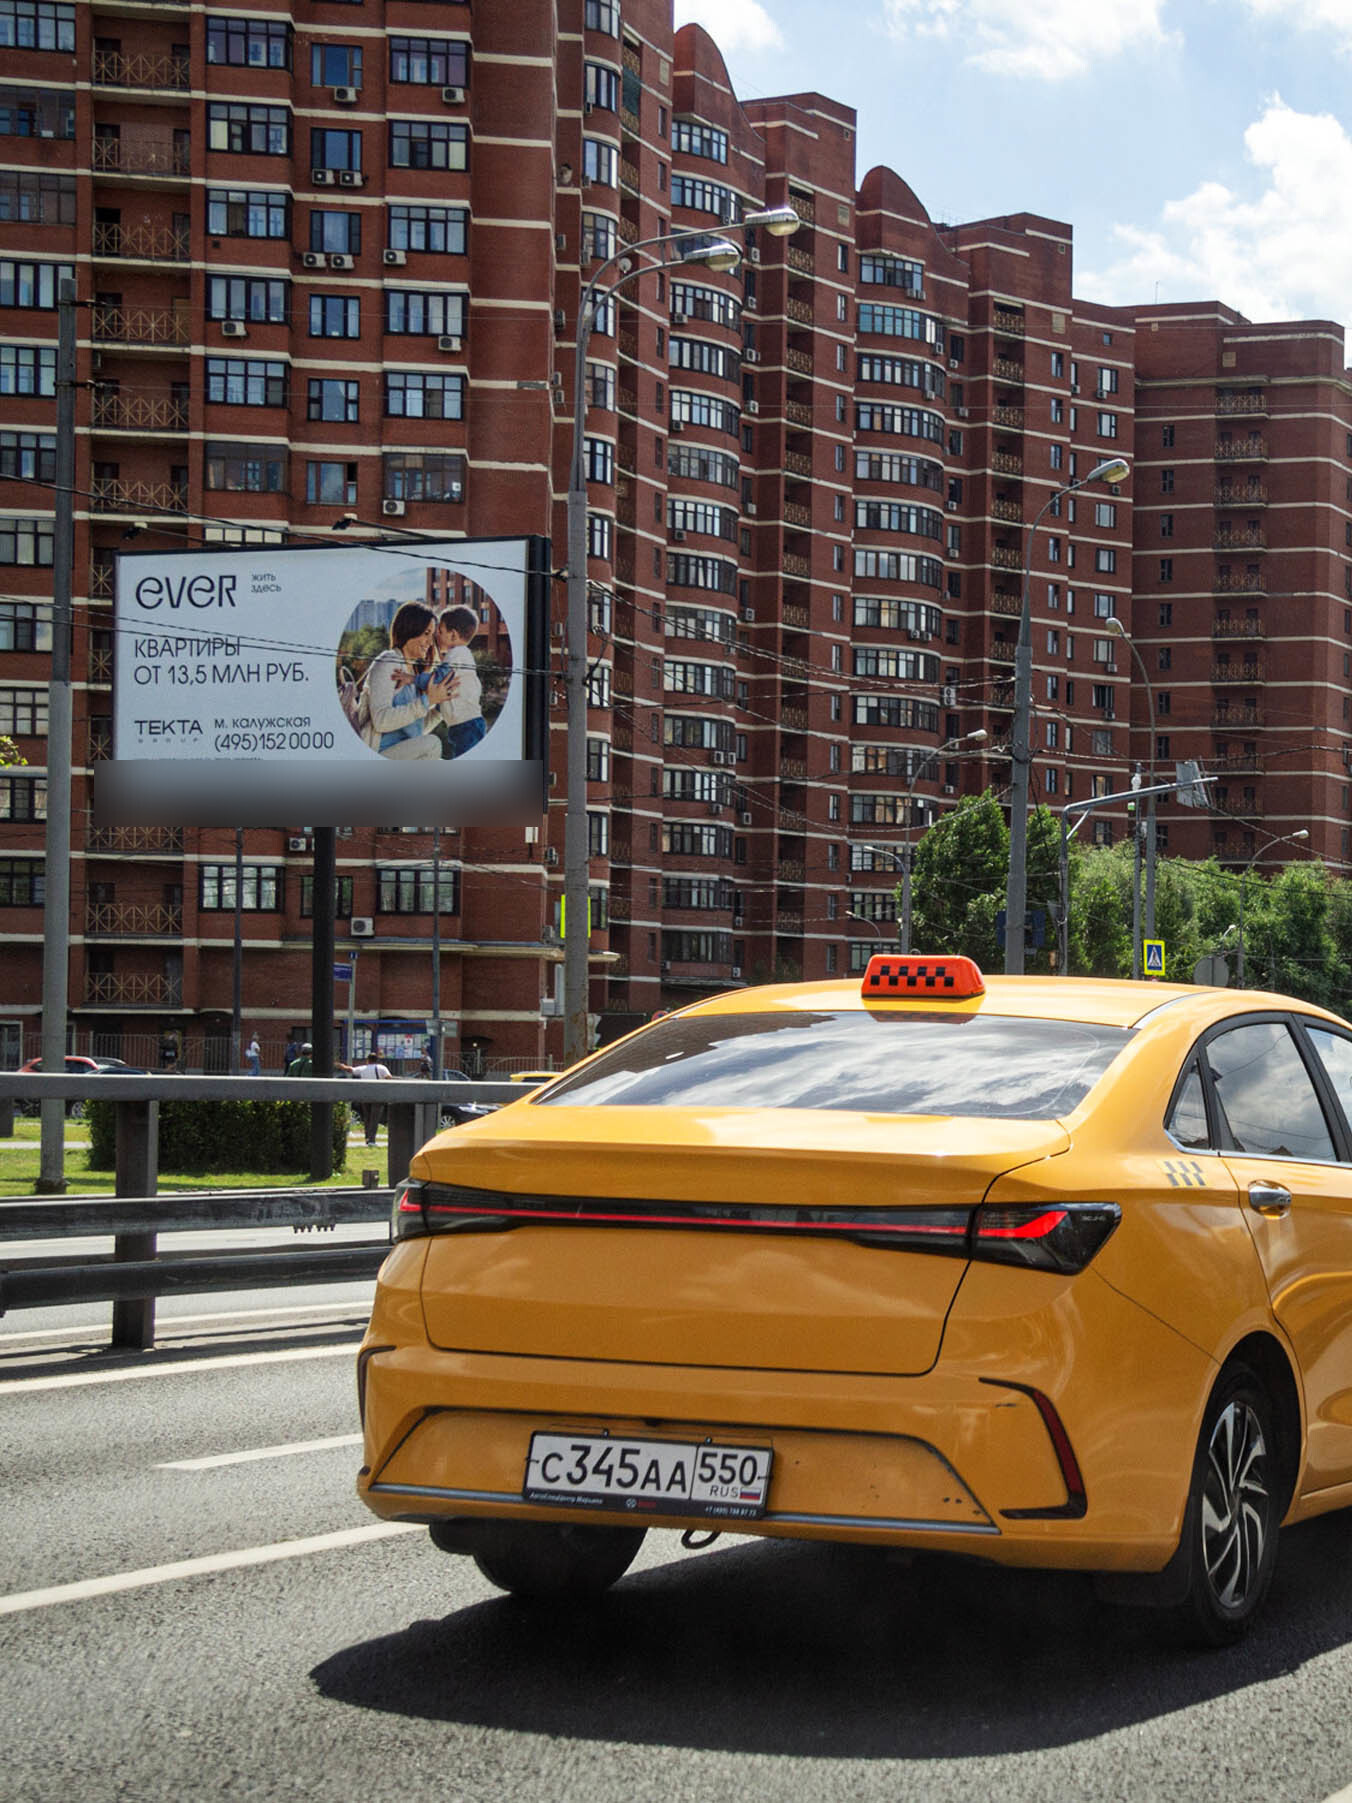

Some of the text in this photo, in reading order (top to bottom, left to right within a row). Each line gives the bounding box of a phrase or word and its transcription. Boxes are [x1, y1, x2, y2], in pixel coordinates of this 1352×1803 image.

[135, 637, 240, 658] КВАРТИРЫ
[134, 662, 310, 686] ОТ 13,5 МЛН РУБ.
[134, 720, 203, 735] ТЕКТА
[214, 716, 311, 731] м. калужская
[541, 1444, 758, 1494] С345АА 550
[709, 1485, 738, 1498] RUS
